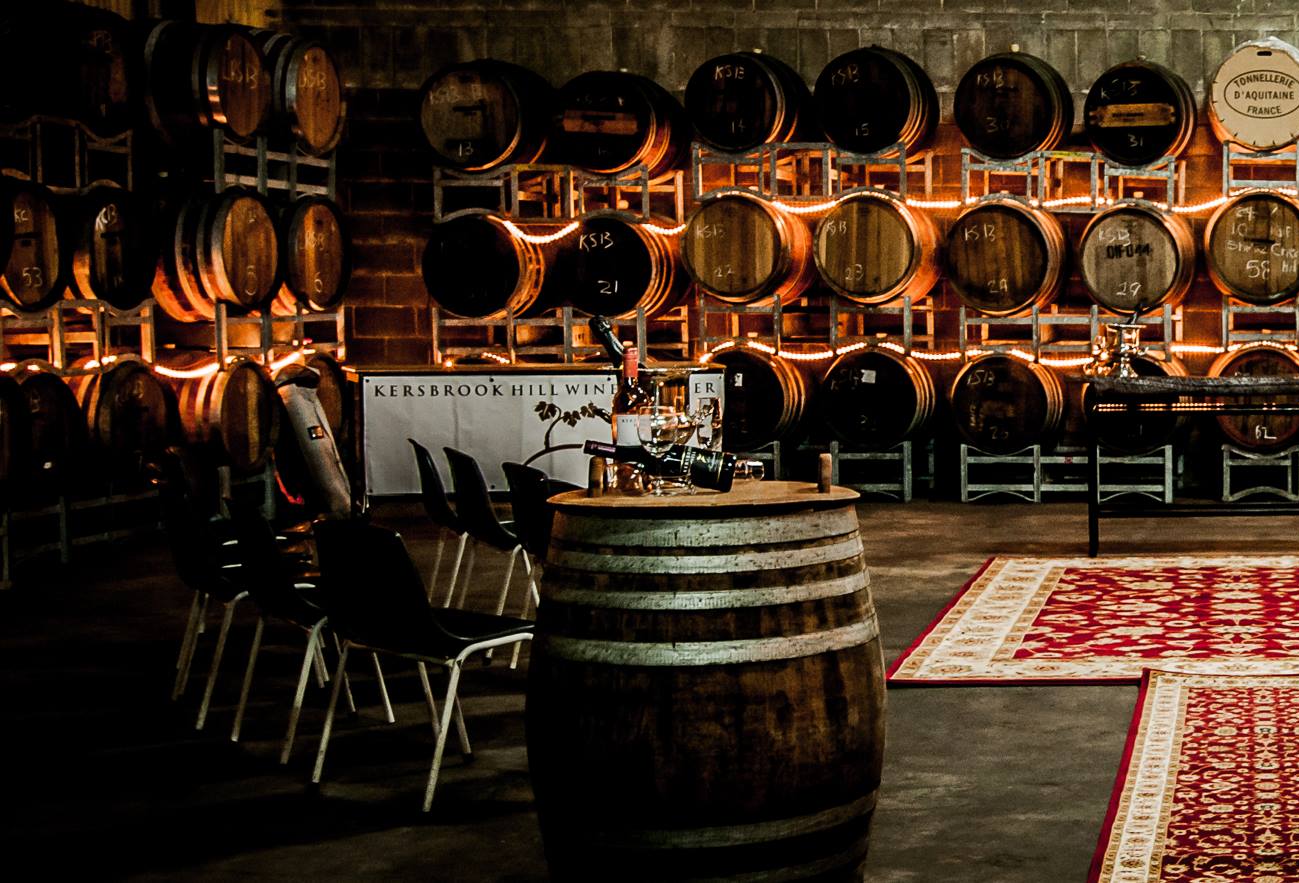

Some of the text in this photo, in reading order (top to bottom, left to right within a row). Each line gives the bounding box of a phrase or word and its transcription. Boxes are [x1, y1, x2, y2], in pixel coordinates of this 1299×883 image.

[714, 64, 746, 81] KS13
[1234, 73, 1295, 89] TONNELLERIE
[1234, 90, 1295, 101] D'AQUITAINE
[1246, 105, 1282, 116] FRANCE
[855, 121, 871, 137] 15
[1127, 133, 1144, 148] 31
[457, 142, 475, 158] 13
[578, 231, 615, 252] KS13
[21, 267, 43, 288] 53
[1246, 259, 1270, 280] 58
[596, 279, 618, 294] 21
[1115, 281, 1142, 297] 29
[374, 384, 504, 397] KERSBROOK
[511, 383, 559, 396] HILL
[567, 383, 618, 396] WINE
